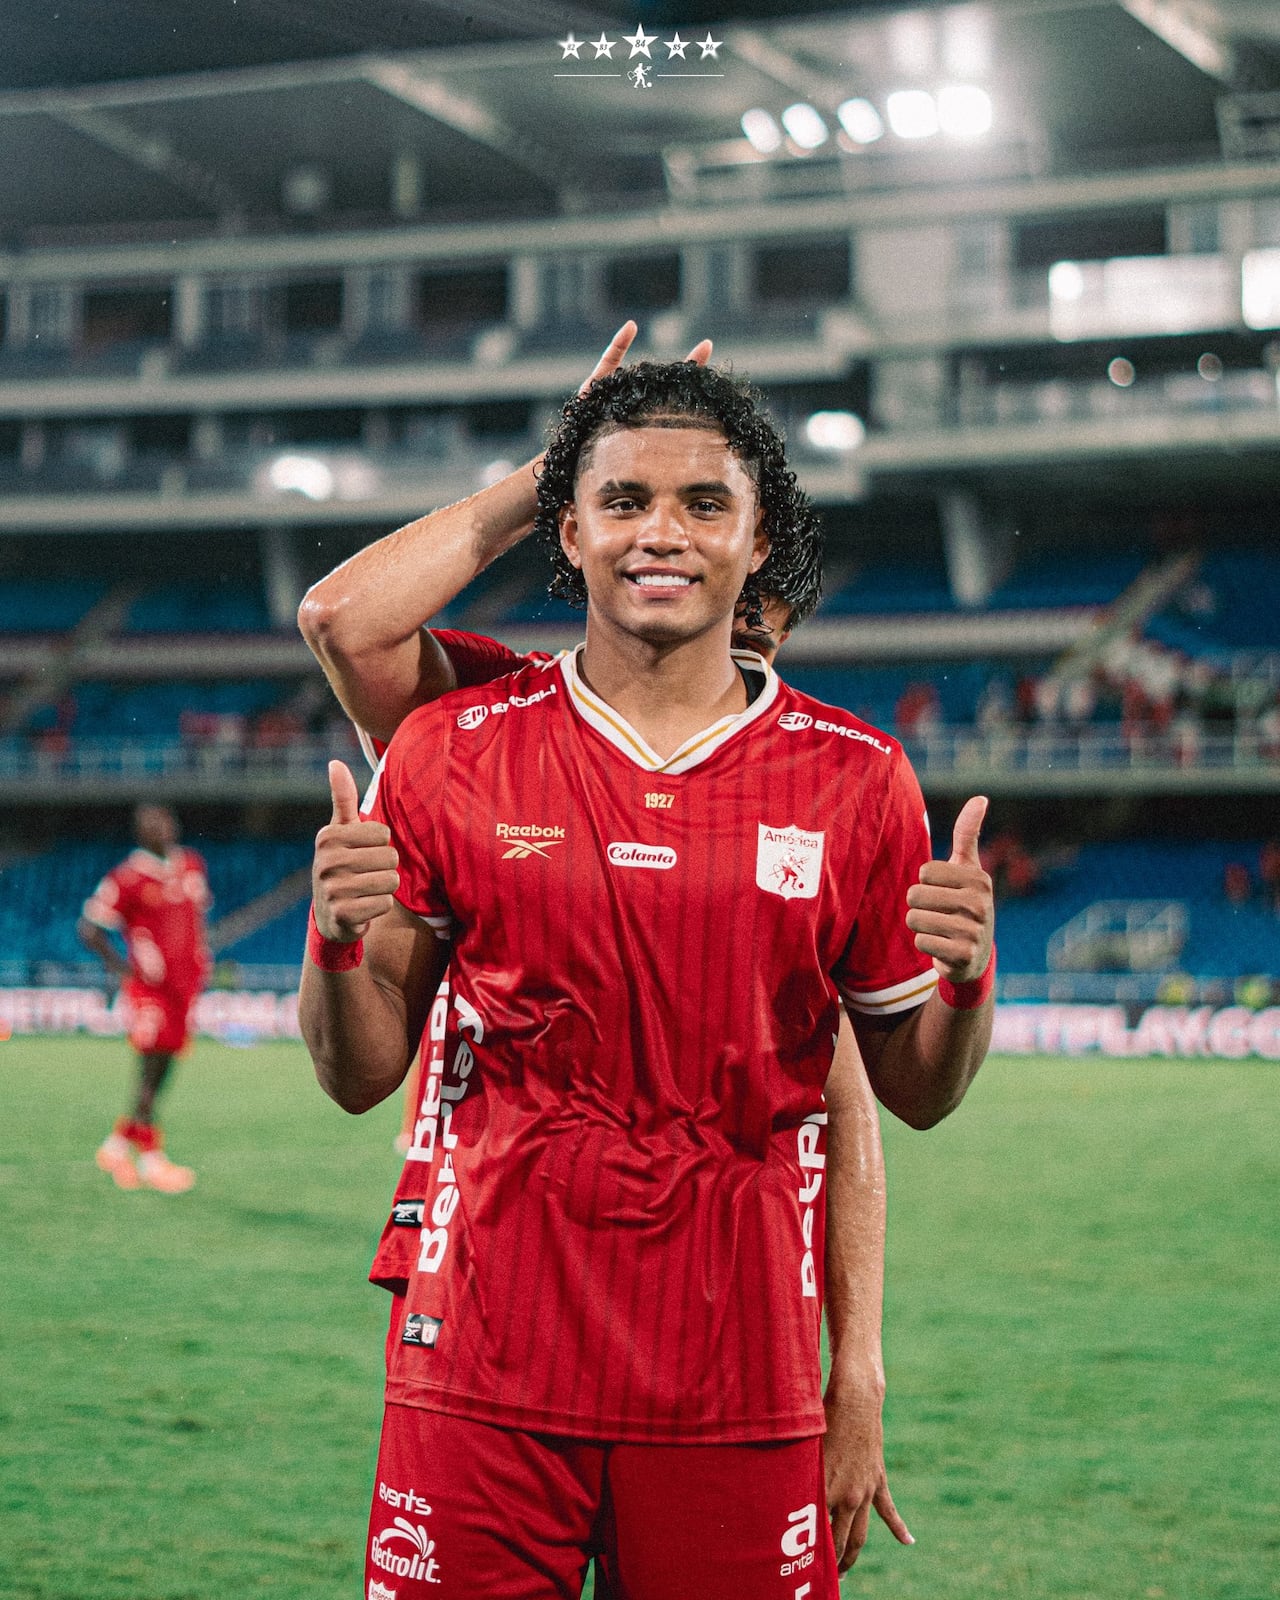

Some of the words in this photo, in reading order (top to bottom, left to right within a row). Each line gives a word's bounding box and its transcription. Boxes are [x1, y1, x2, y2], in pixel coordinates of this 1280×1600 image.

[814, 719, 892, 755] EMCALI
[644, 792, 676, 809] 1927
[496, 822, 565, 839] Reebok
[764, 830, 818, 849] América
[609, 846, 674, 864] Colanta
[378, 1481, 433, 1516] events
